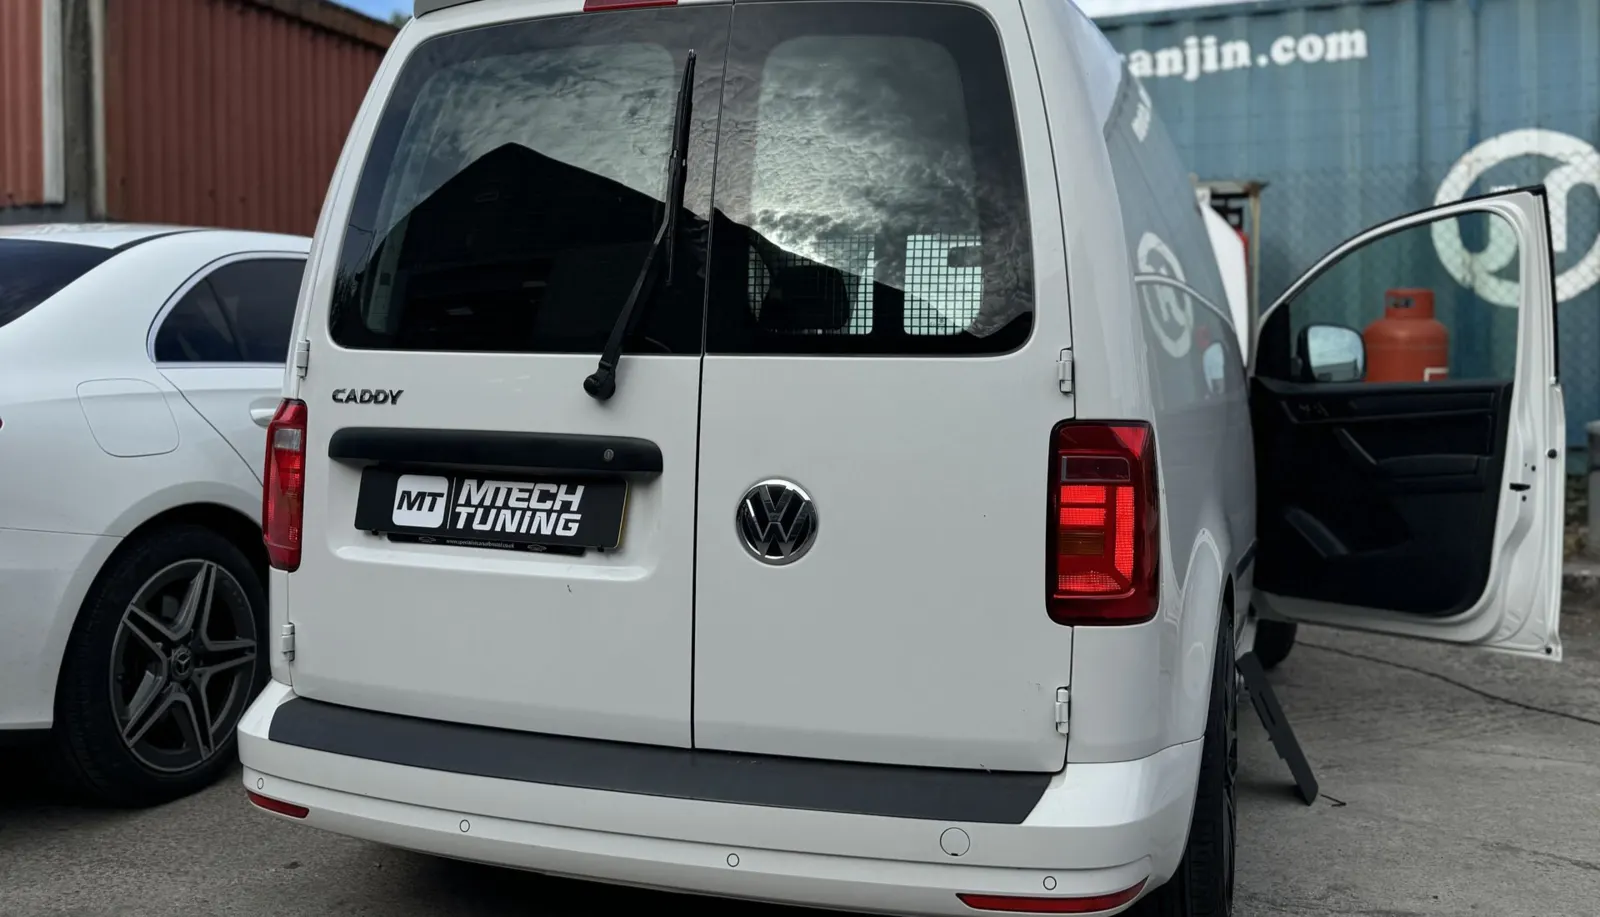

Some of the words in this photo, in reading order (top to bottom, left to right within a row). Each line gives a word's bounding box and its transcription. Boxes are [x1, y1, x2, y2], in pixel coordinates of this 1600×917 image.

[1120, 29, 1368, 81] anjin.com
[331, 388, 404, 406] CADDY
[396, 490, 445, 513] MT
[456, 479, 585, 511] MTECH
[455, 506, 582, 537] TUNING
